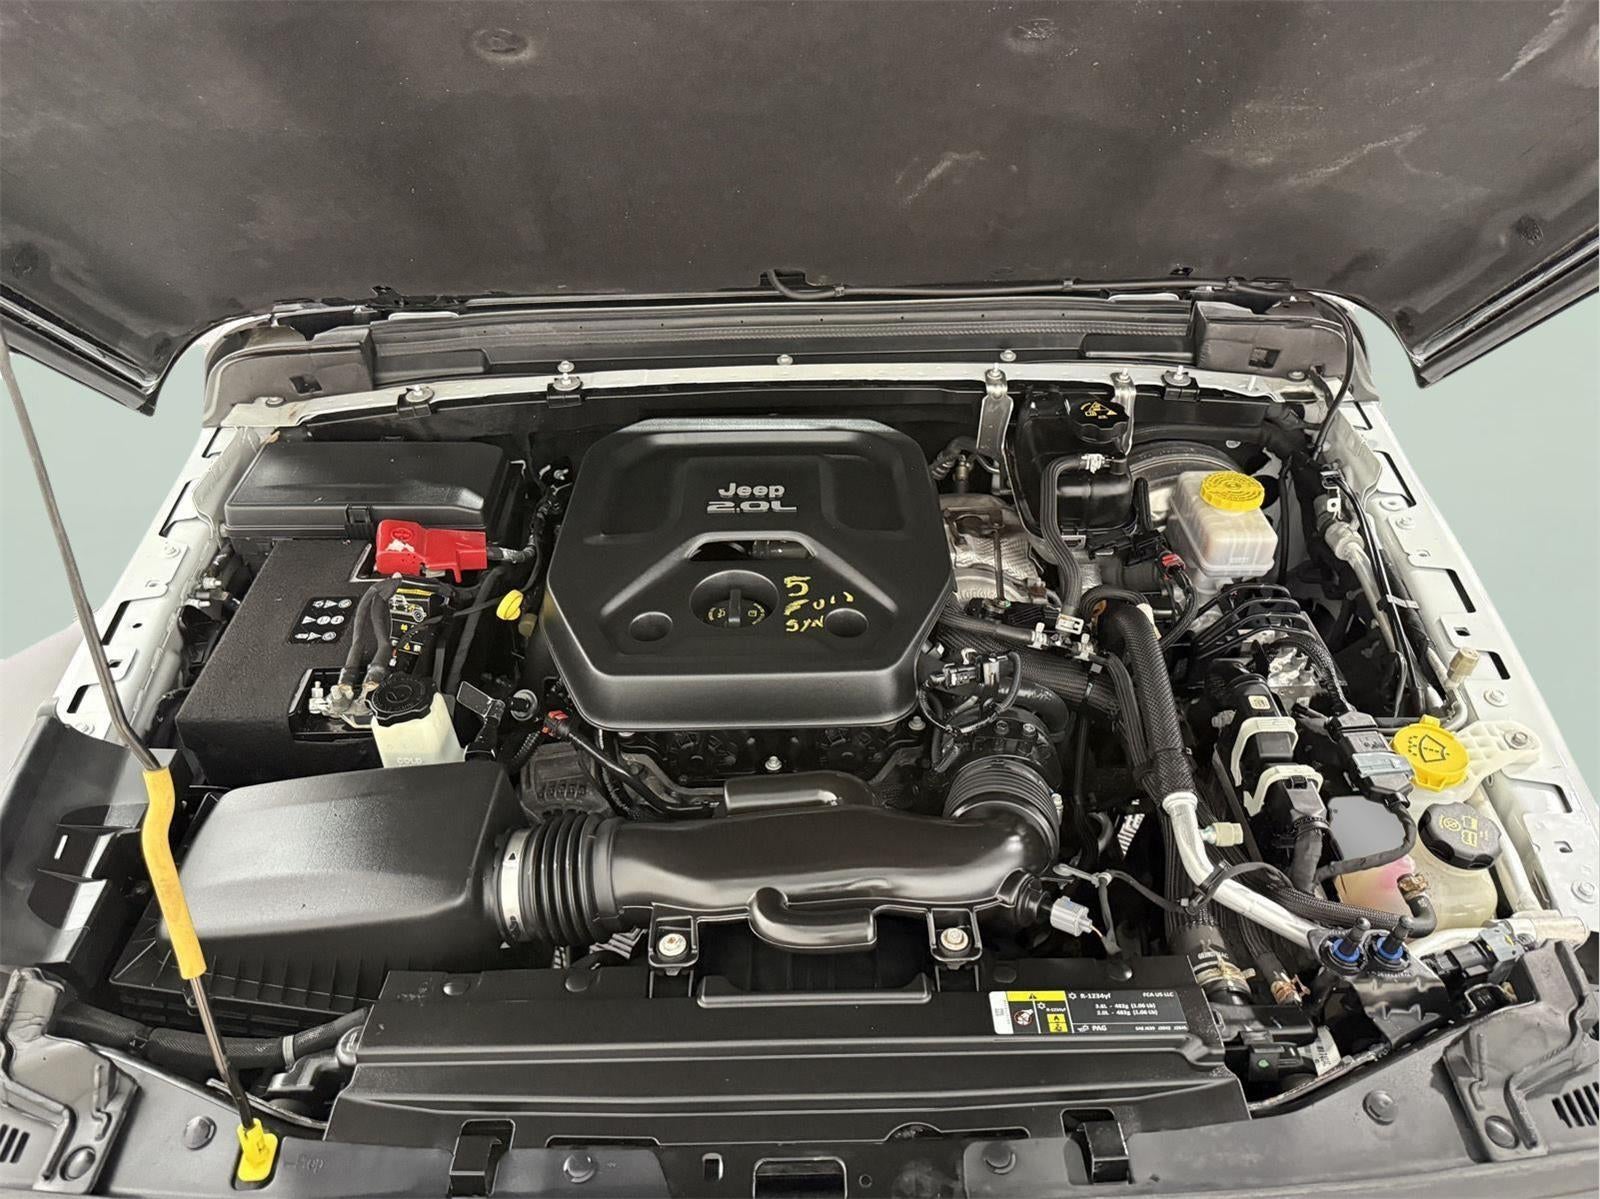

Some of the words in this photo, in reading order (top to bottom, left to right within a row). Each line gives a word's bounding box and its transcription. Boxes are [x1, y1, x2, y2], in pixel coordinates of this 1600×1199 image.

[718, 482, 785, 497] Jeep
[707, 500, 797, 513] 2.0L
[784, 575, 811, 596] 5
[1080, 992, 1111, 1000] R-1234yf
